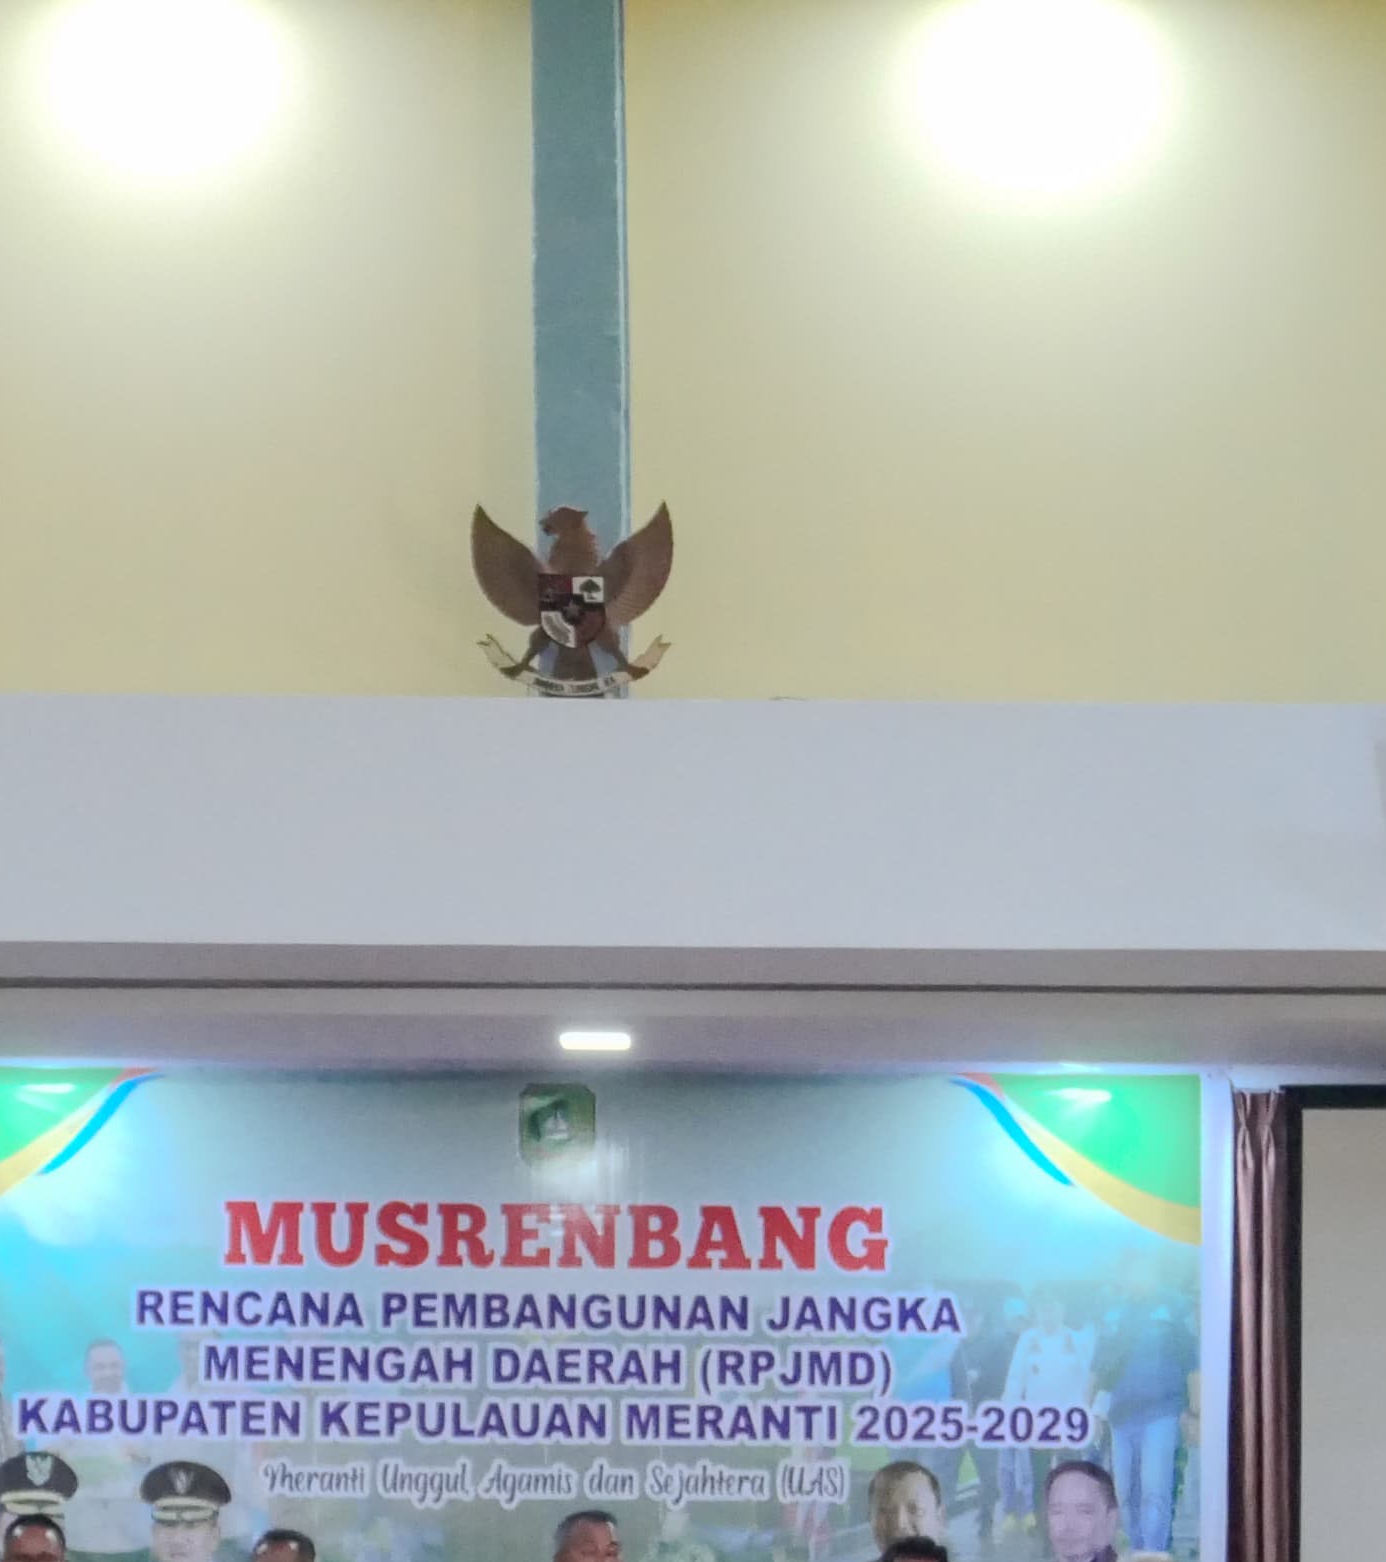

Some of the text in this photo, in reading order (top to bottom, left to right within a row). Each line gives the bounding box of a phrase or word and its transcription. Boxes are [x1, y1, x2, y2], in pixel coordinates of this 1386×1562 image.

[223, 1200, 889, 1273] MUSRENBANG
[135, 1291, 962, 1334] RENCANA PEMBANGUNAN JANGKA
[204, 1346, 893, 1395] MENENGAH DAERAH (RPJMD)
[18, 1399, 1091, 1446] KABUPATEN KEPULAUAN MERANTI 2025-2029
[263, 1461, 365, 1494] Meranti
[484, 1463, 573, 1502] Agamis
[588, 1464, 635, 1495] dan
[649, 1465, 765, 1504] Sejahtera
[780, 1466, 845, 1498] (UAS)
